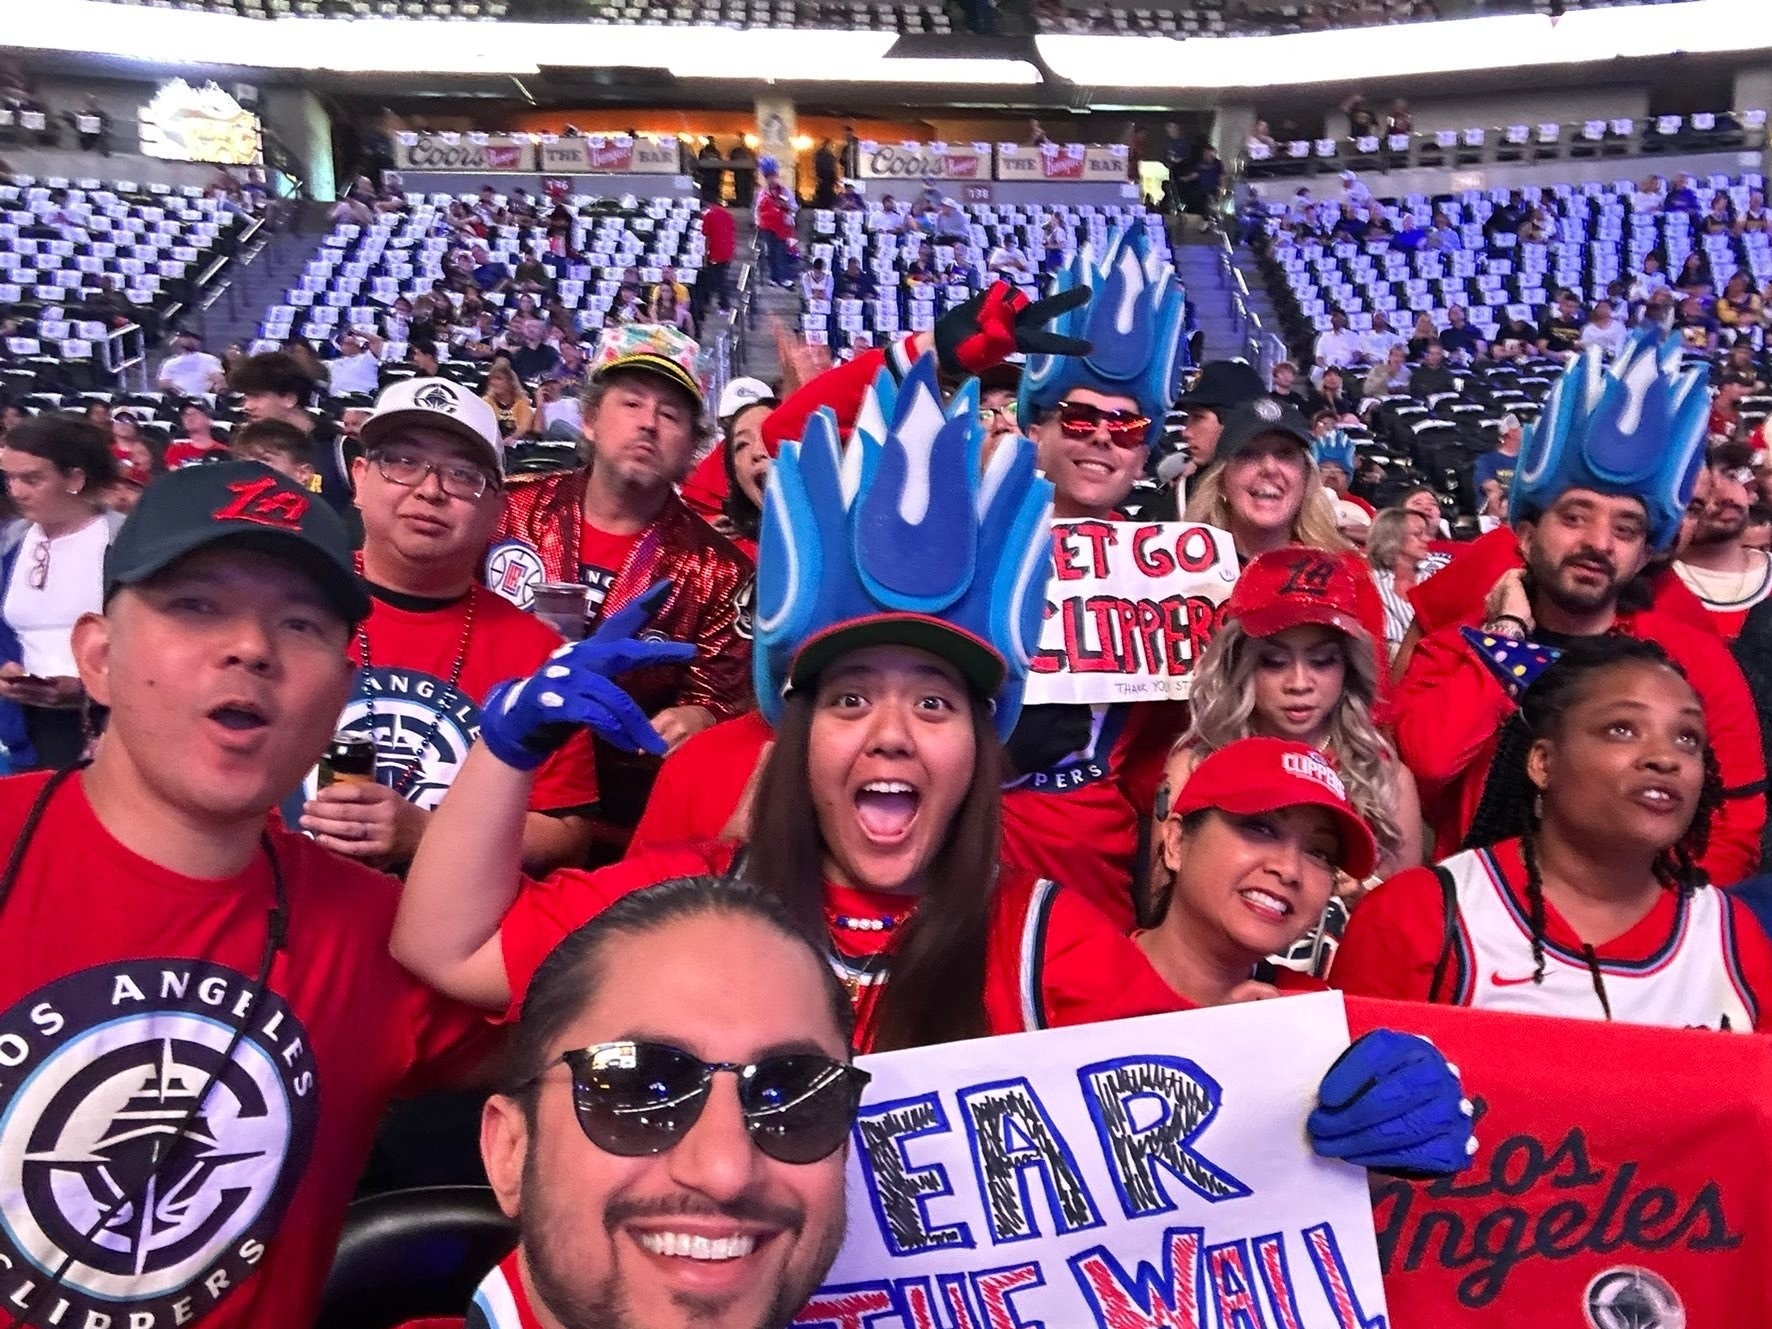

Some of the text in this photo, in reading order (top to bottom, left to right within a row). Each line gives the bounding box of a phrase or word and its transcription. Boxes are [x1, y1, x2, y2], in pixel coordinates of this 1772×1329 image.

[408, 138, 485, 167] Coors
[549, 149, 581, 162] THE
[639, 151, 672, 163] BAR
[870, 146, 944, 175] Coors
[1003, 158, 1036, 171] THE
[1089, 159, 1123, 172] BAR
[211, 476, 310, 532] LA
[1132, 526, 1221, 578] GO
[1277, 555, 1336, 596] LA
[362, 675, 481, 741] ANGELE
[1114, 682, 1148, 695] THANK
[1175, 680, 1190, 692] ST
[1034, 764, 1103, 788] PERS
[0, 970, 316, 1098] OS ANGELES
[856, 1054, 1253, 1257] EAR
[0, 1238, 265, 1329] LIPPERS
